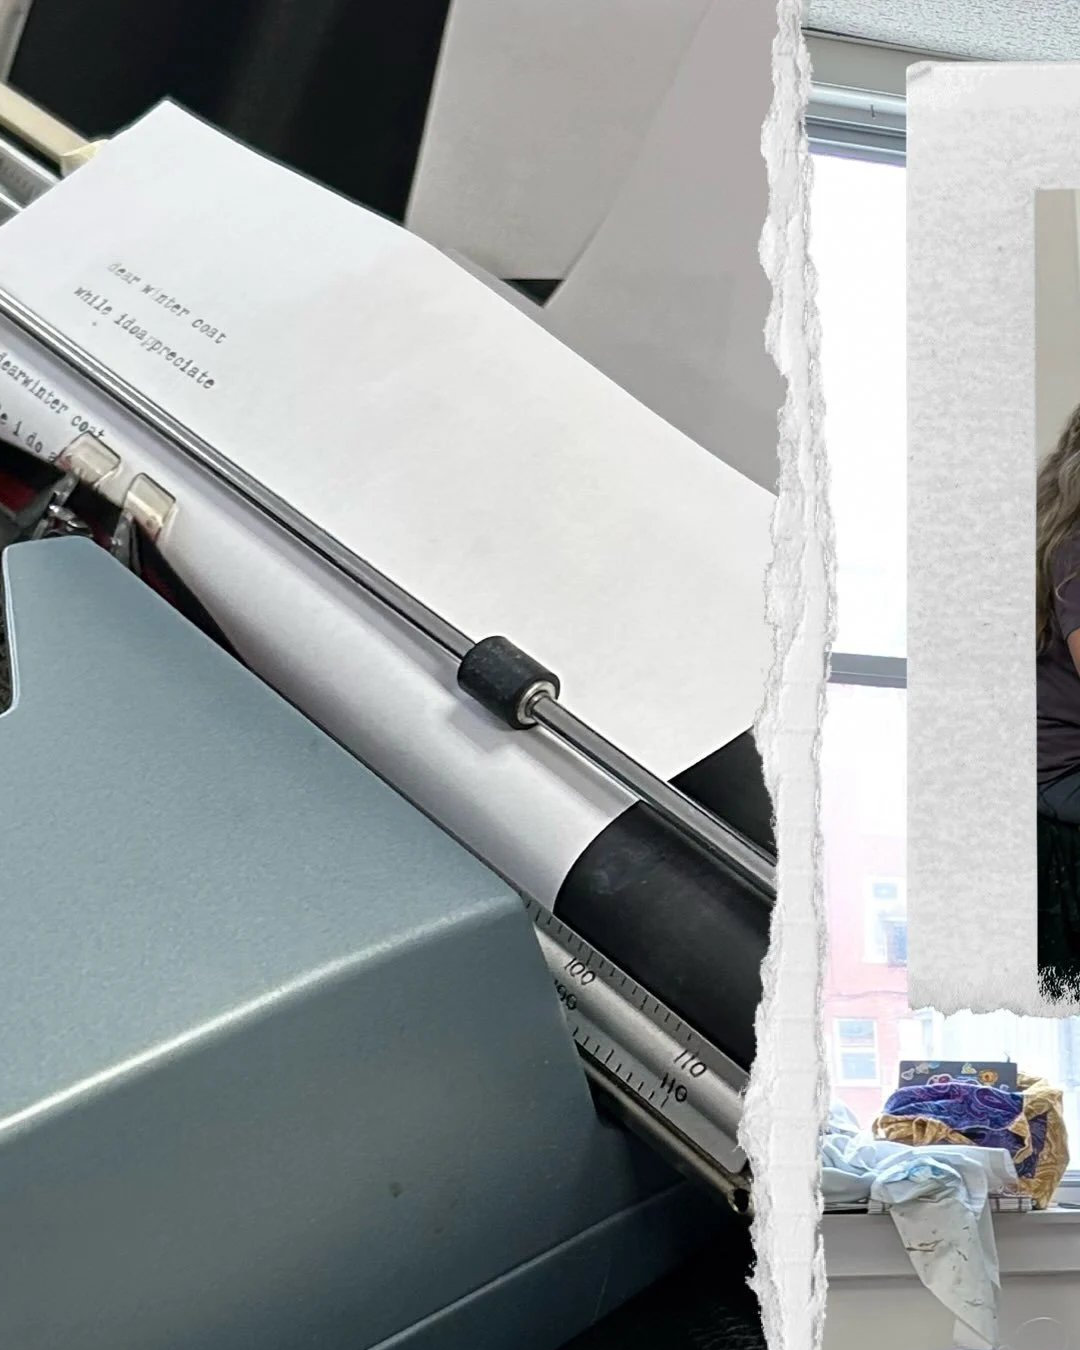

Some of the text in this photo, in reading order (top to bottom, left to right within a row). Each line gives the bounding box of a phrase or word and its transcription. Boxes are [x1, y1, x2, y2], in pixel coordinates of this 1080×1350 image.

[73, 286, 113, 316] while
[107, 262, 227, 344] dear winter coat
[25, 432, 44, 454] do
[564, 957, 596, 986] 100
[673, 1049, 708, 1079] 110
[660, 1072, 688, 1103] 110
